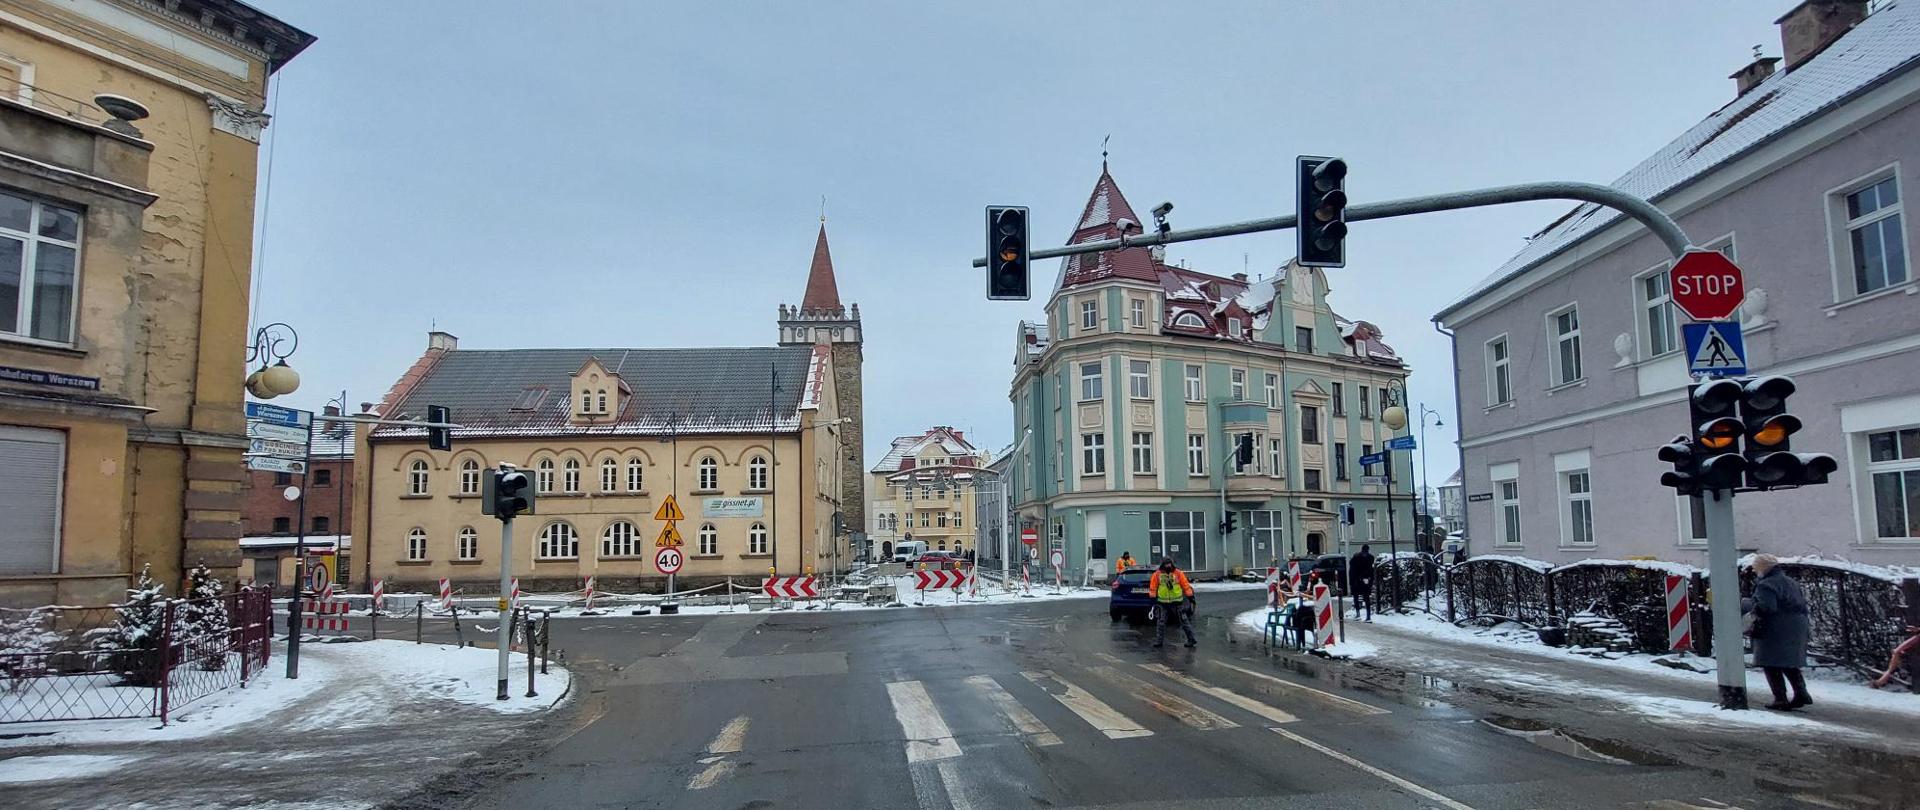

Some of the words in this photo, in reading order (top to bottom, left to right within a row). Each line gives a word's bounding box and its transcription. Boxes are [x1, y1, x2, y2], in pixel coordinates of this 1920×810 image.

[1677, 275, 1736, 295] STOP
[257, 410, 289, 421] Warszawy
[721, 499, 757, 508] gissnet.pl
